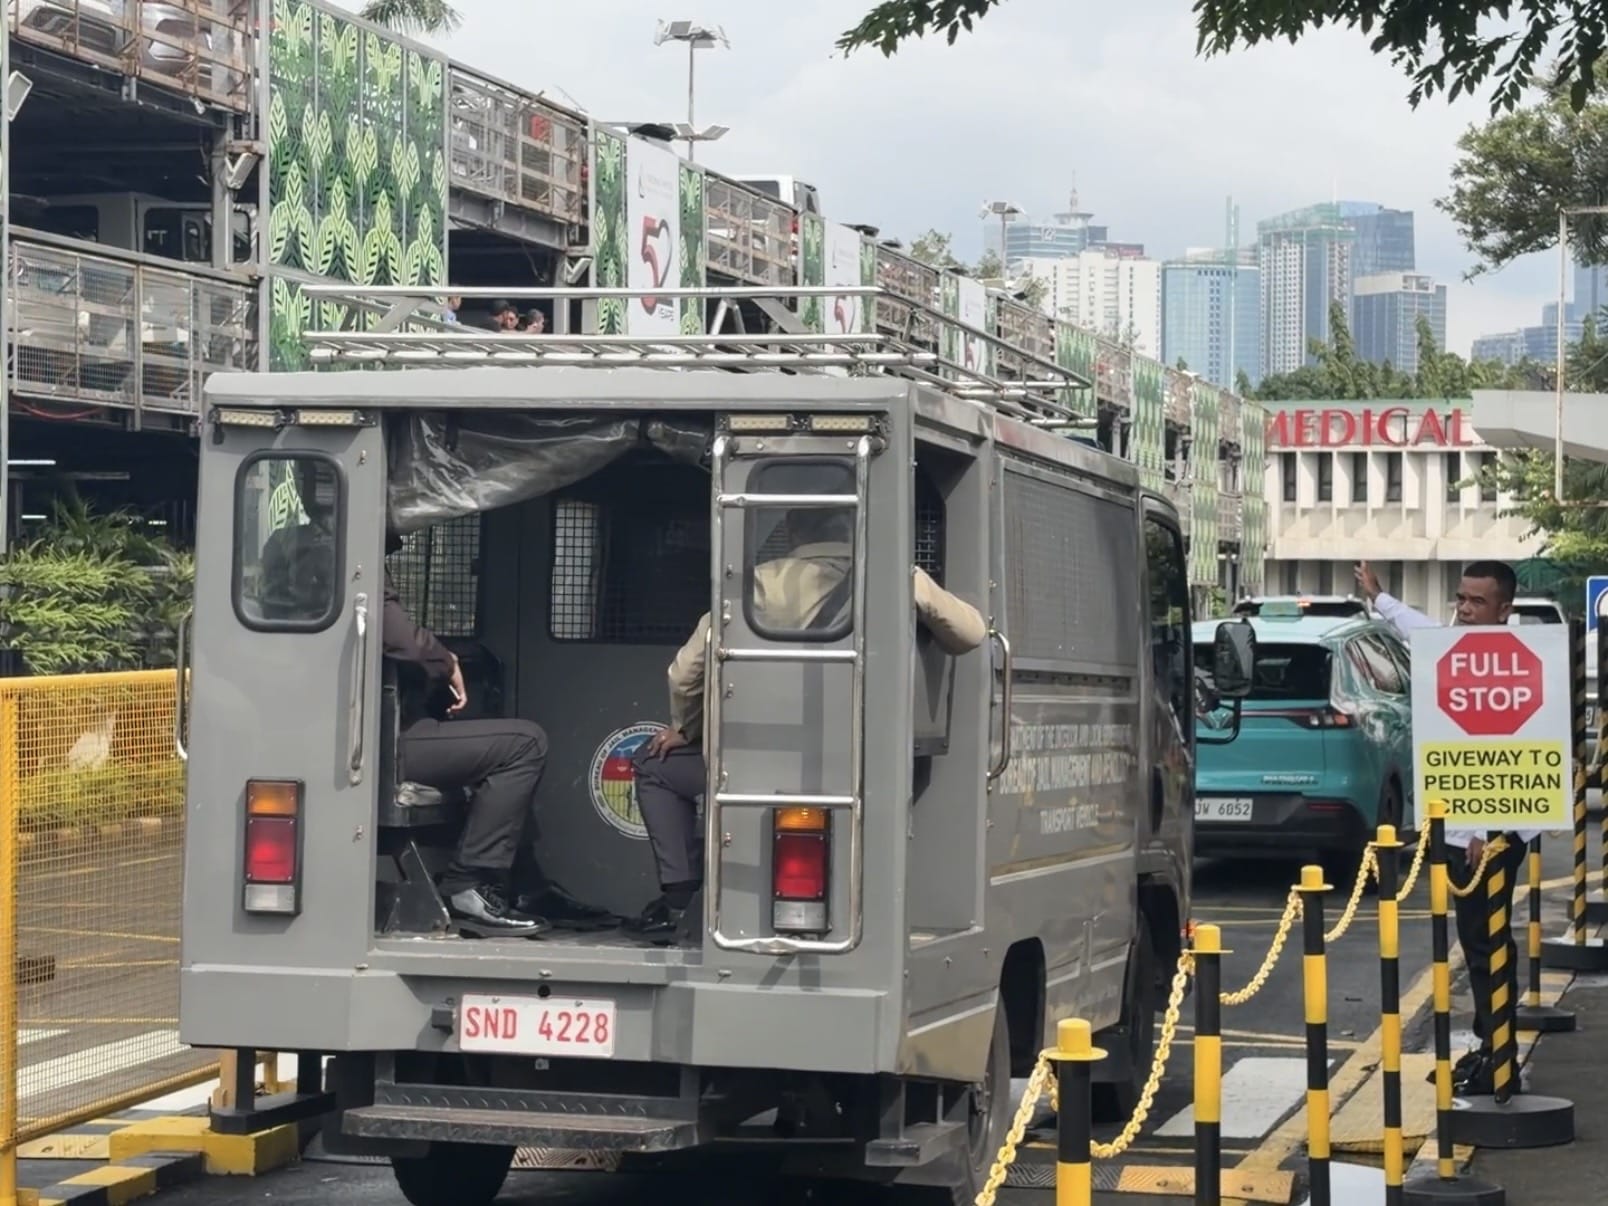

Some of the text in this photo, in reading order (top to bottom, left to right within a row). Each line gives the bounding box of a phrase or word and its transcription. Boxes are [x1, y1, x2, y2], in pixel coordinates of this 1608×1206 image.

[1450, 652, 1529, 677] FULL
[1449, 686, 1532, 712] STOP
[1426, 750, 1561, 767] GIVEWAY TO
[1425, 773, 1561, 791] PEDESTRIAN
[1218, 803, 1250, 816] 6052
[465, 1006, 609, 1044] SND 4228
